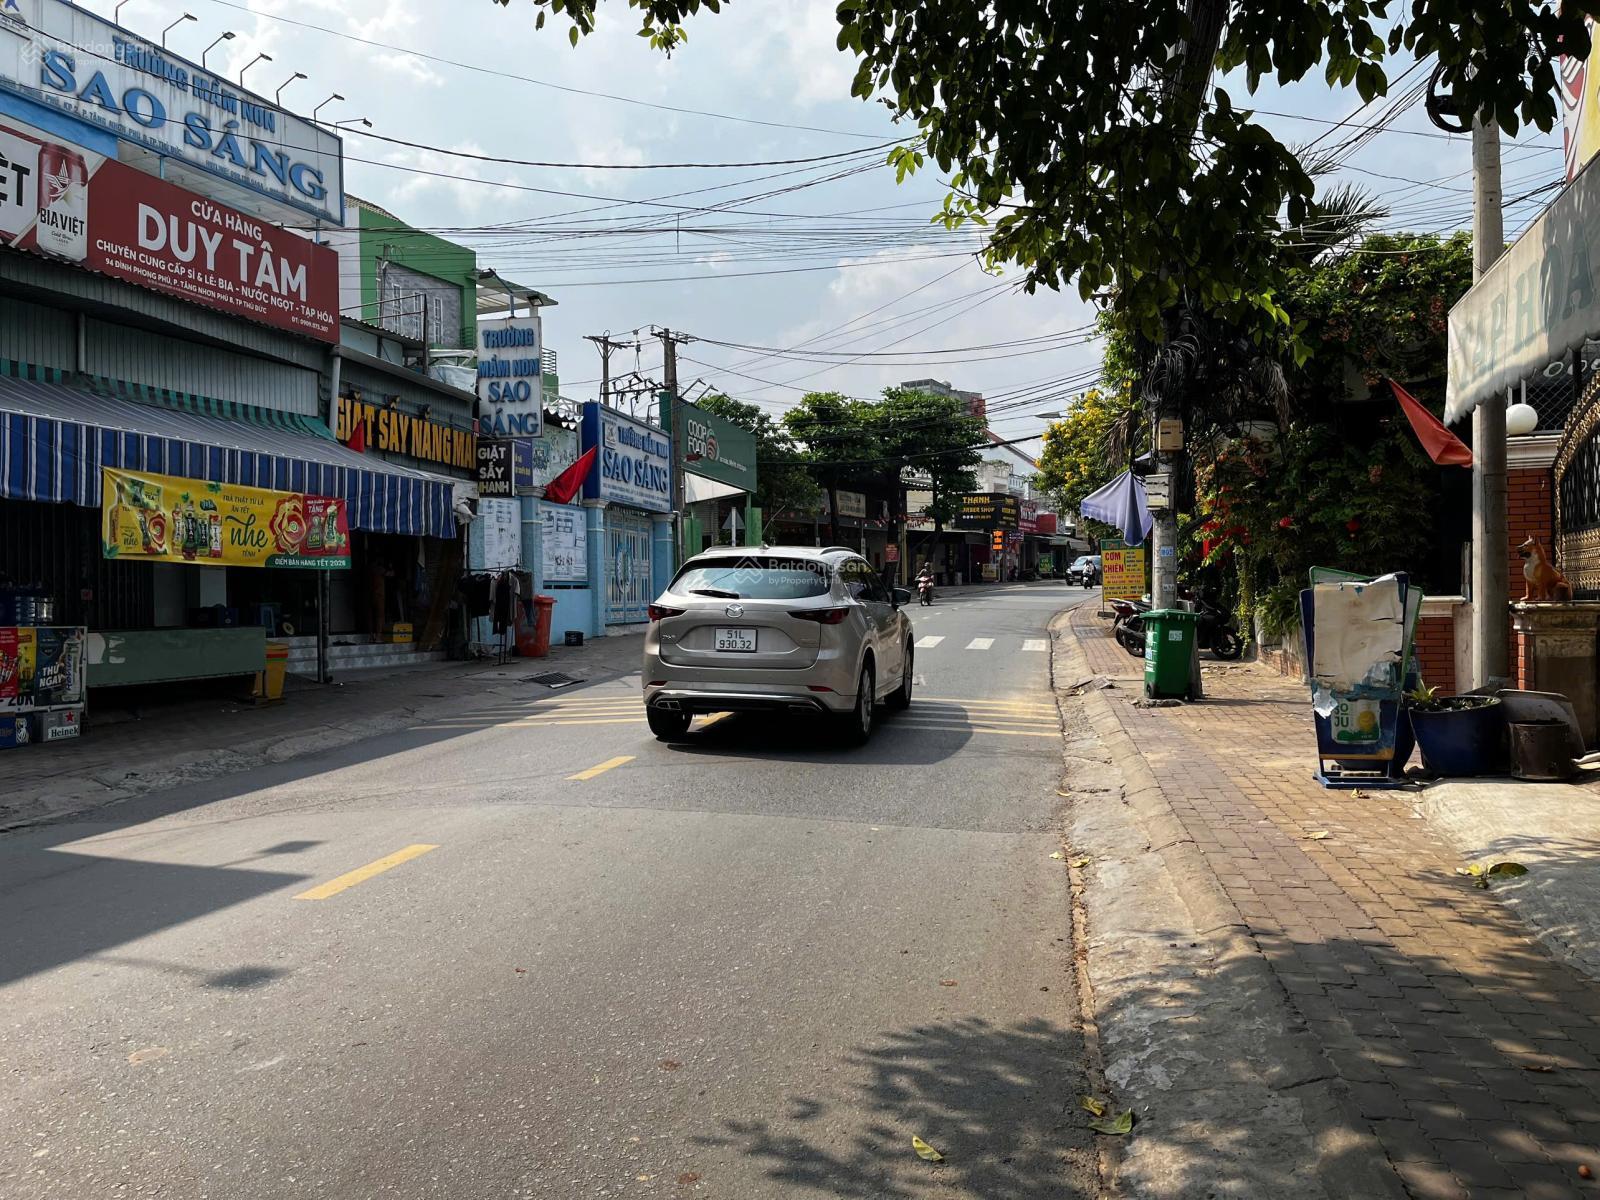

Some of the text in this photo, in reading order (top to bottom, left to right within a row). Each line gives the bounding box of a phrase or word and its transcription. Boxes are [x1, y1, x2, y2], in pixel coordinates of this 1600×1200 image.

[41, 50, 167, 129] SAO
[184, 112, 329, 201] SÁNG
[240, 97, 276, 134] NON
[40, 207, 85, 237] BIA VIỆT
[191, 200, 262, 240] CỬA HÀNG
[138, 202, 307, 303] DUY TÂM
[96, 239, 137, 260] CHUYÊN
[138, 253, 166, 270] CUNG
[167, 261, 186, 276] CẤP
[196, 272, 203, 282] &
[218, 278, 234, 292] BIA
[241, 285, 269, 304] NƯỚC
[270, 295, 295, 312] NGỌT
[300, 305, 316, 320] TẠP
[316, 310, 334, 325] HÓA
[114, 259, 132, 273] ĐÌNH
[133, 266, 157, 280] PHONG
[173, 279, 180, 287] P.
[180, 281, 198, 293] TĂNG
[198, 286, 216, 298] NHƠN
[217, 293, 229, 302] PHÚ
[236, 298, 243, 306] TP
[254, 303, 267, 314] ĐỨC
[482, 324, 535, 348] TRƯỜNG
[512, 357, 540, 377] NON
[488, 380, 531, 403] SAO
[378, 395, 409, 454] SẤY
[479, 407, 539, 436] SÁNG
[477, 444, 507, 462] GIẶT
[687, 435, 707, 457] FOOD
[602, 448, 634, 484] SAO
[634, 454, 668, 494] SÁNG
[240, 505, 250, 514] TẾT
[225, 513, 269, 553] nhẹ
[300, 559, 316, 567] HÀNG
[316, 557, 330, 568] TẾT
[1103, 562, 1124, 573] CHIÊN
[1104, 551, 1121, 561] CƠM
[719, 639, 752, 650] 930.32
[727, 629, 745, 640] 51L
[42, 661, 60, 677] THỬ
[39, 673, 64, 689] NGAY
[1334, 716, 1349, 728] JU
